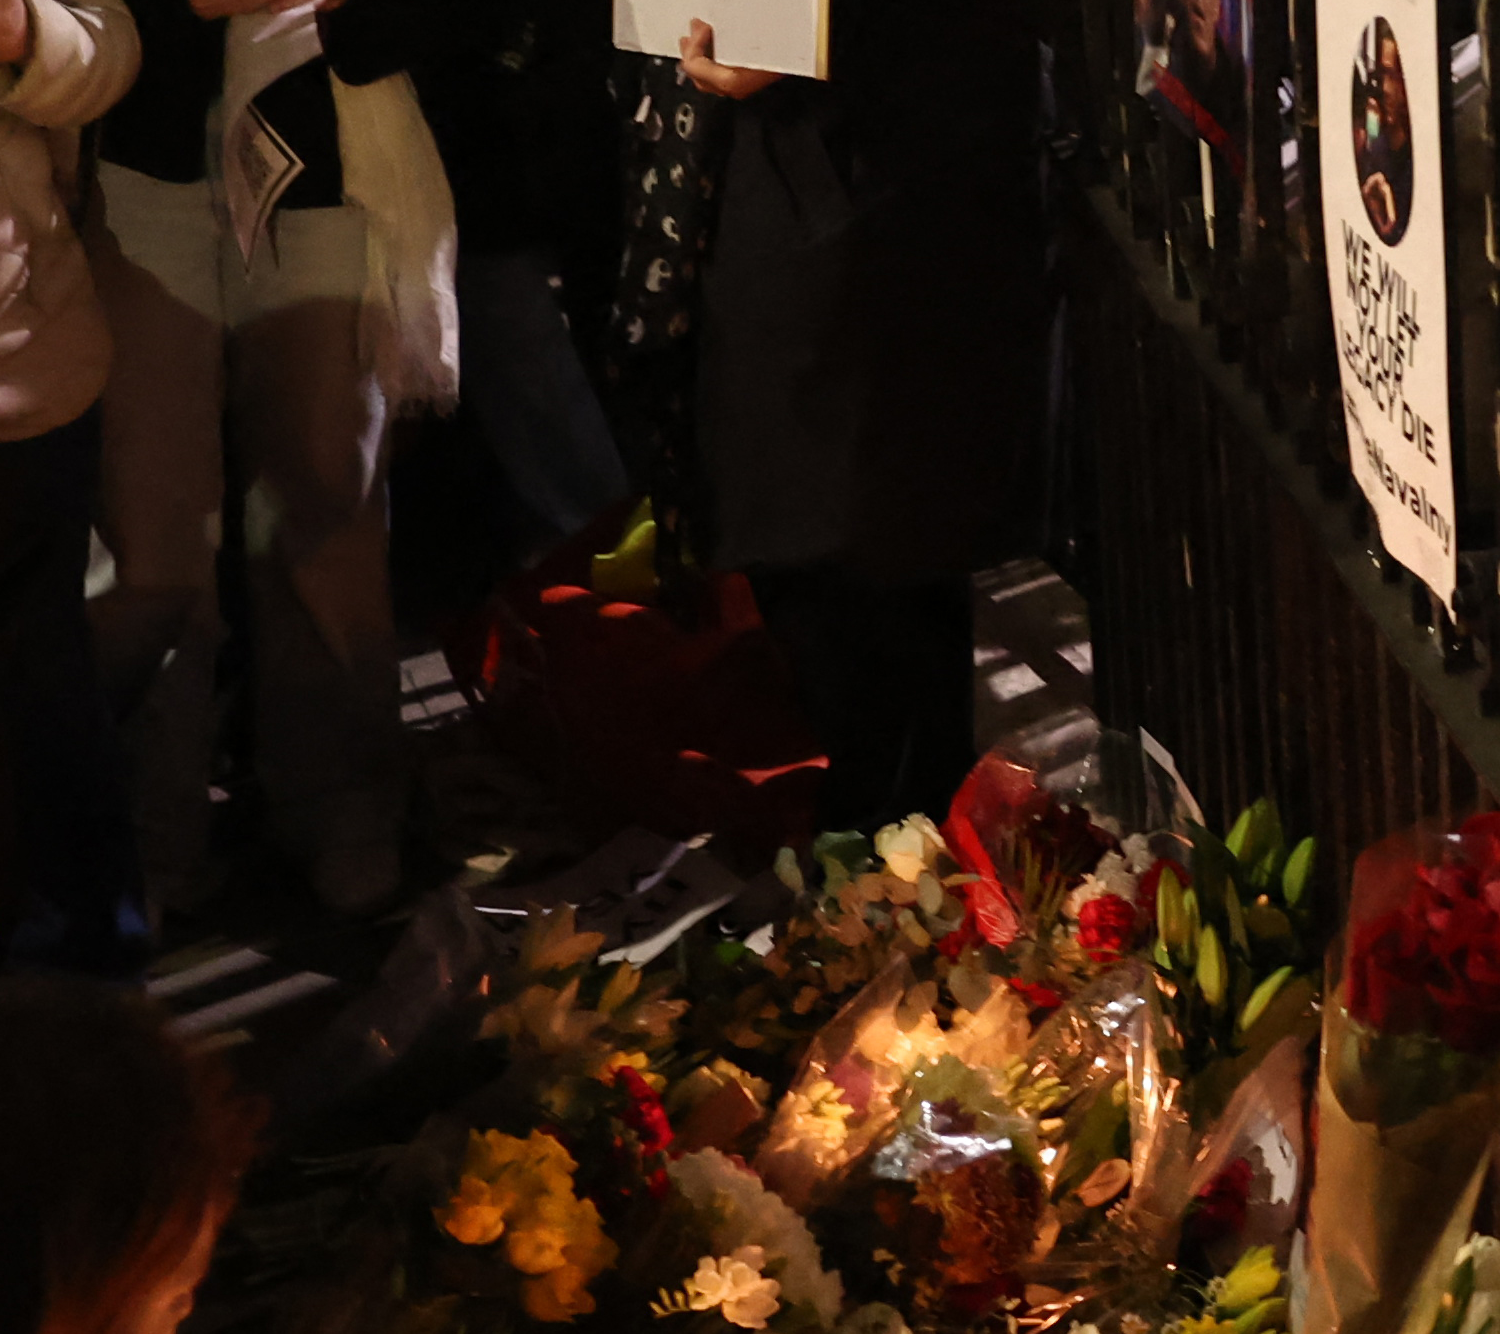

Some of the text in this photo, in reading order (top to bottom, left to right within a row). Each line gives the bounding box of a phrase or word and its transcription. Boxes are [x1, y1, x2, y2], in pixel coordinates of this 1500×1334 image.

[1341, 218, 1421, 335] WE WILL
[1346, 265, 1418, 368] NOT LET
[1356, 306, 1404, 397] YOUR
[1402, 399, 1439, 468] DIE
